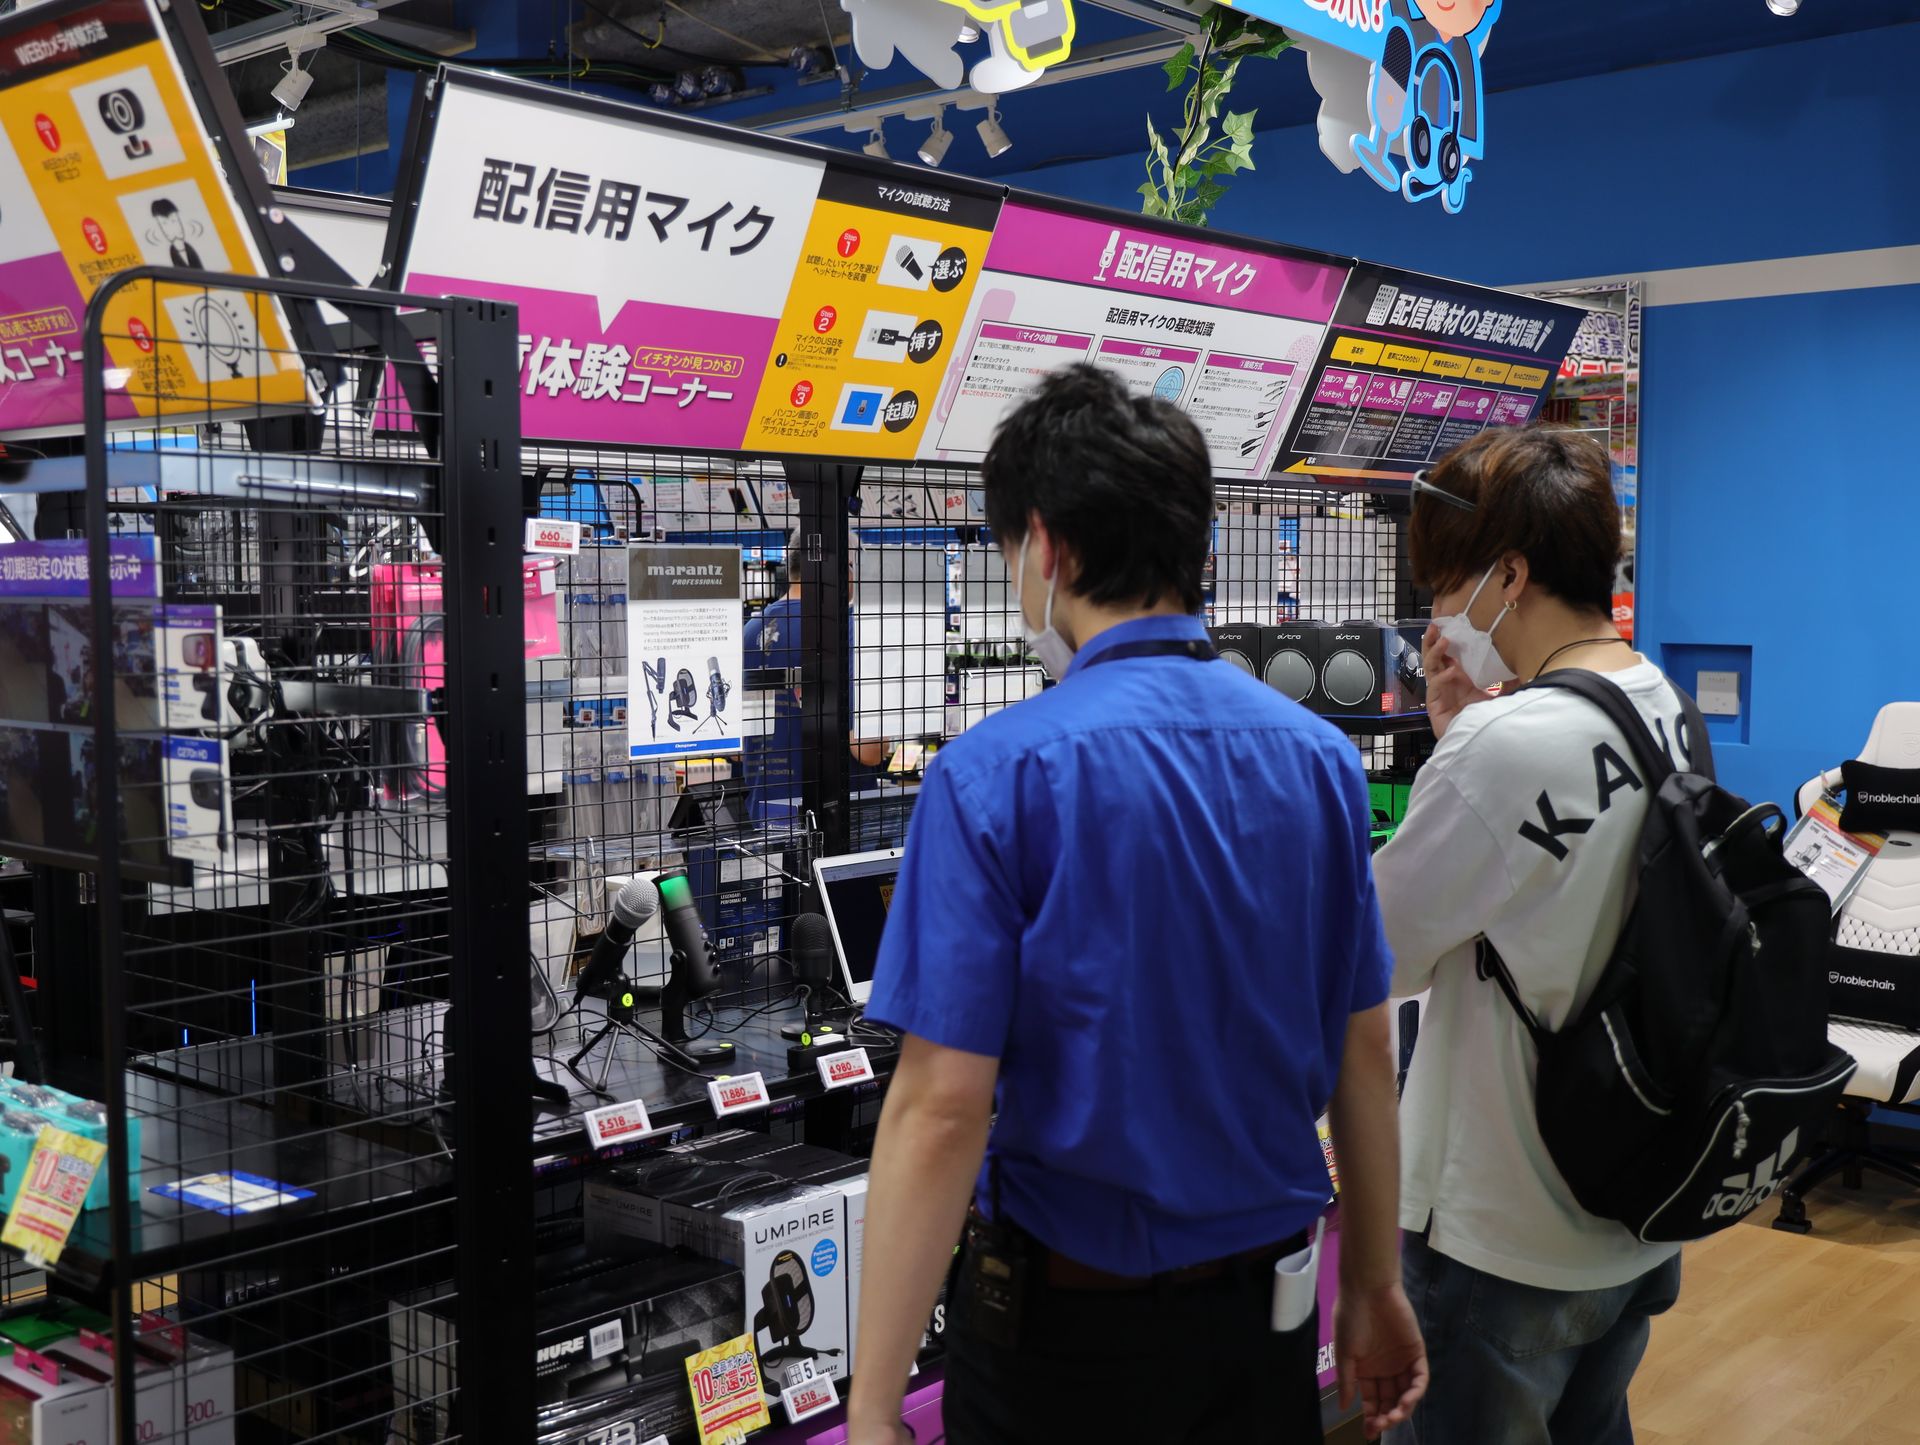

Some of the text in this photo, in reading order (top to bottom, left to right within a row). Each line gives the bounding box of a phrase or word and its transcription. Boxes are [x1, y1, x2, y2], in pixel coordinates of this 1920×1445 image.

[473, 156, 775, 257] 配信用マイク
[878, 186, 951, 213] マイクの試聴方法
[844, 241, 851, 255] 1
[806, 254, 879, 274] 試聴したいマイクを選び
[933, 258, 965, 281] 選ぶ
[1114, 240, 1257, 298] 配信用マイク
[812, 266, 867, 283] ヘッドセットを装着
[818, 317, 829, 331] 2
[1105, 306, 1216, 338] 配信用マイクの基礎知識
[1389, 292, 1542, 350] 配信機材の基礎知識
[793, 344, 839, 356] パソコンに挿す
[796, 334, 843, 348] マイクのUSBを
[909, 330, 941, 352] 挿す
[0, 340, 84, 384] コーナー
[642, 351, 736, 373] イチオシが見つかる!
[795, 391, 806, 405] 3
[773, 407, 818, 419] パソコン画面の
[884, 400, 917, 422] 起動
[761, 425, 819, 438] アプリを立ち上げる
[540, 530, 560, 541] 660
[647, 564, 723, 576] marantz
[672, 578, 723, 586] PROFESSIONAL
[1839, 973, 1896, 991] noblechairs
[755, 1208, 835, 1245] UMPIRE
[537, 1335, 585, 1363] HURE
[803, 1361, 813, 1379] 5
[693, 1363, 757, 1405] 10%還元
